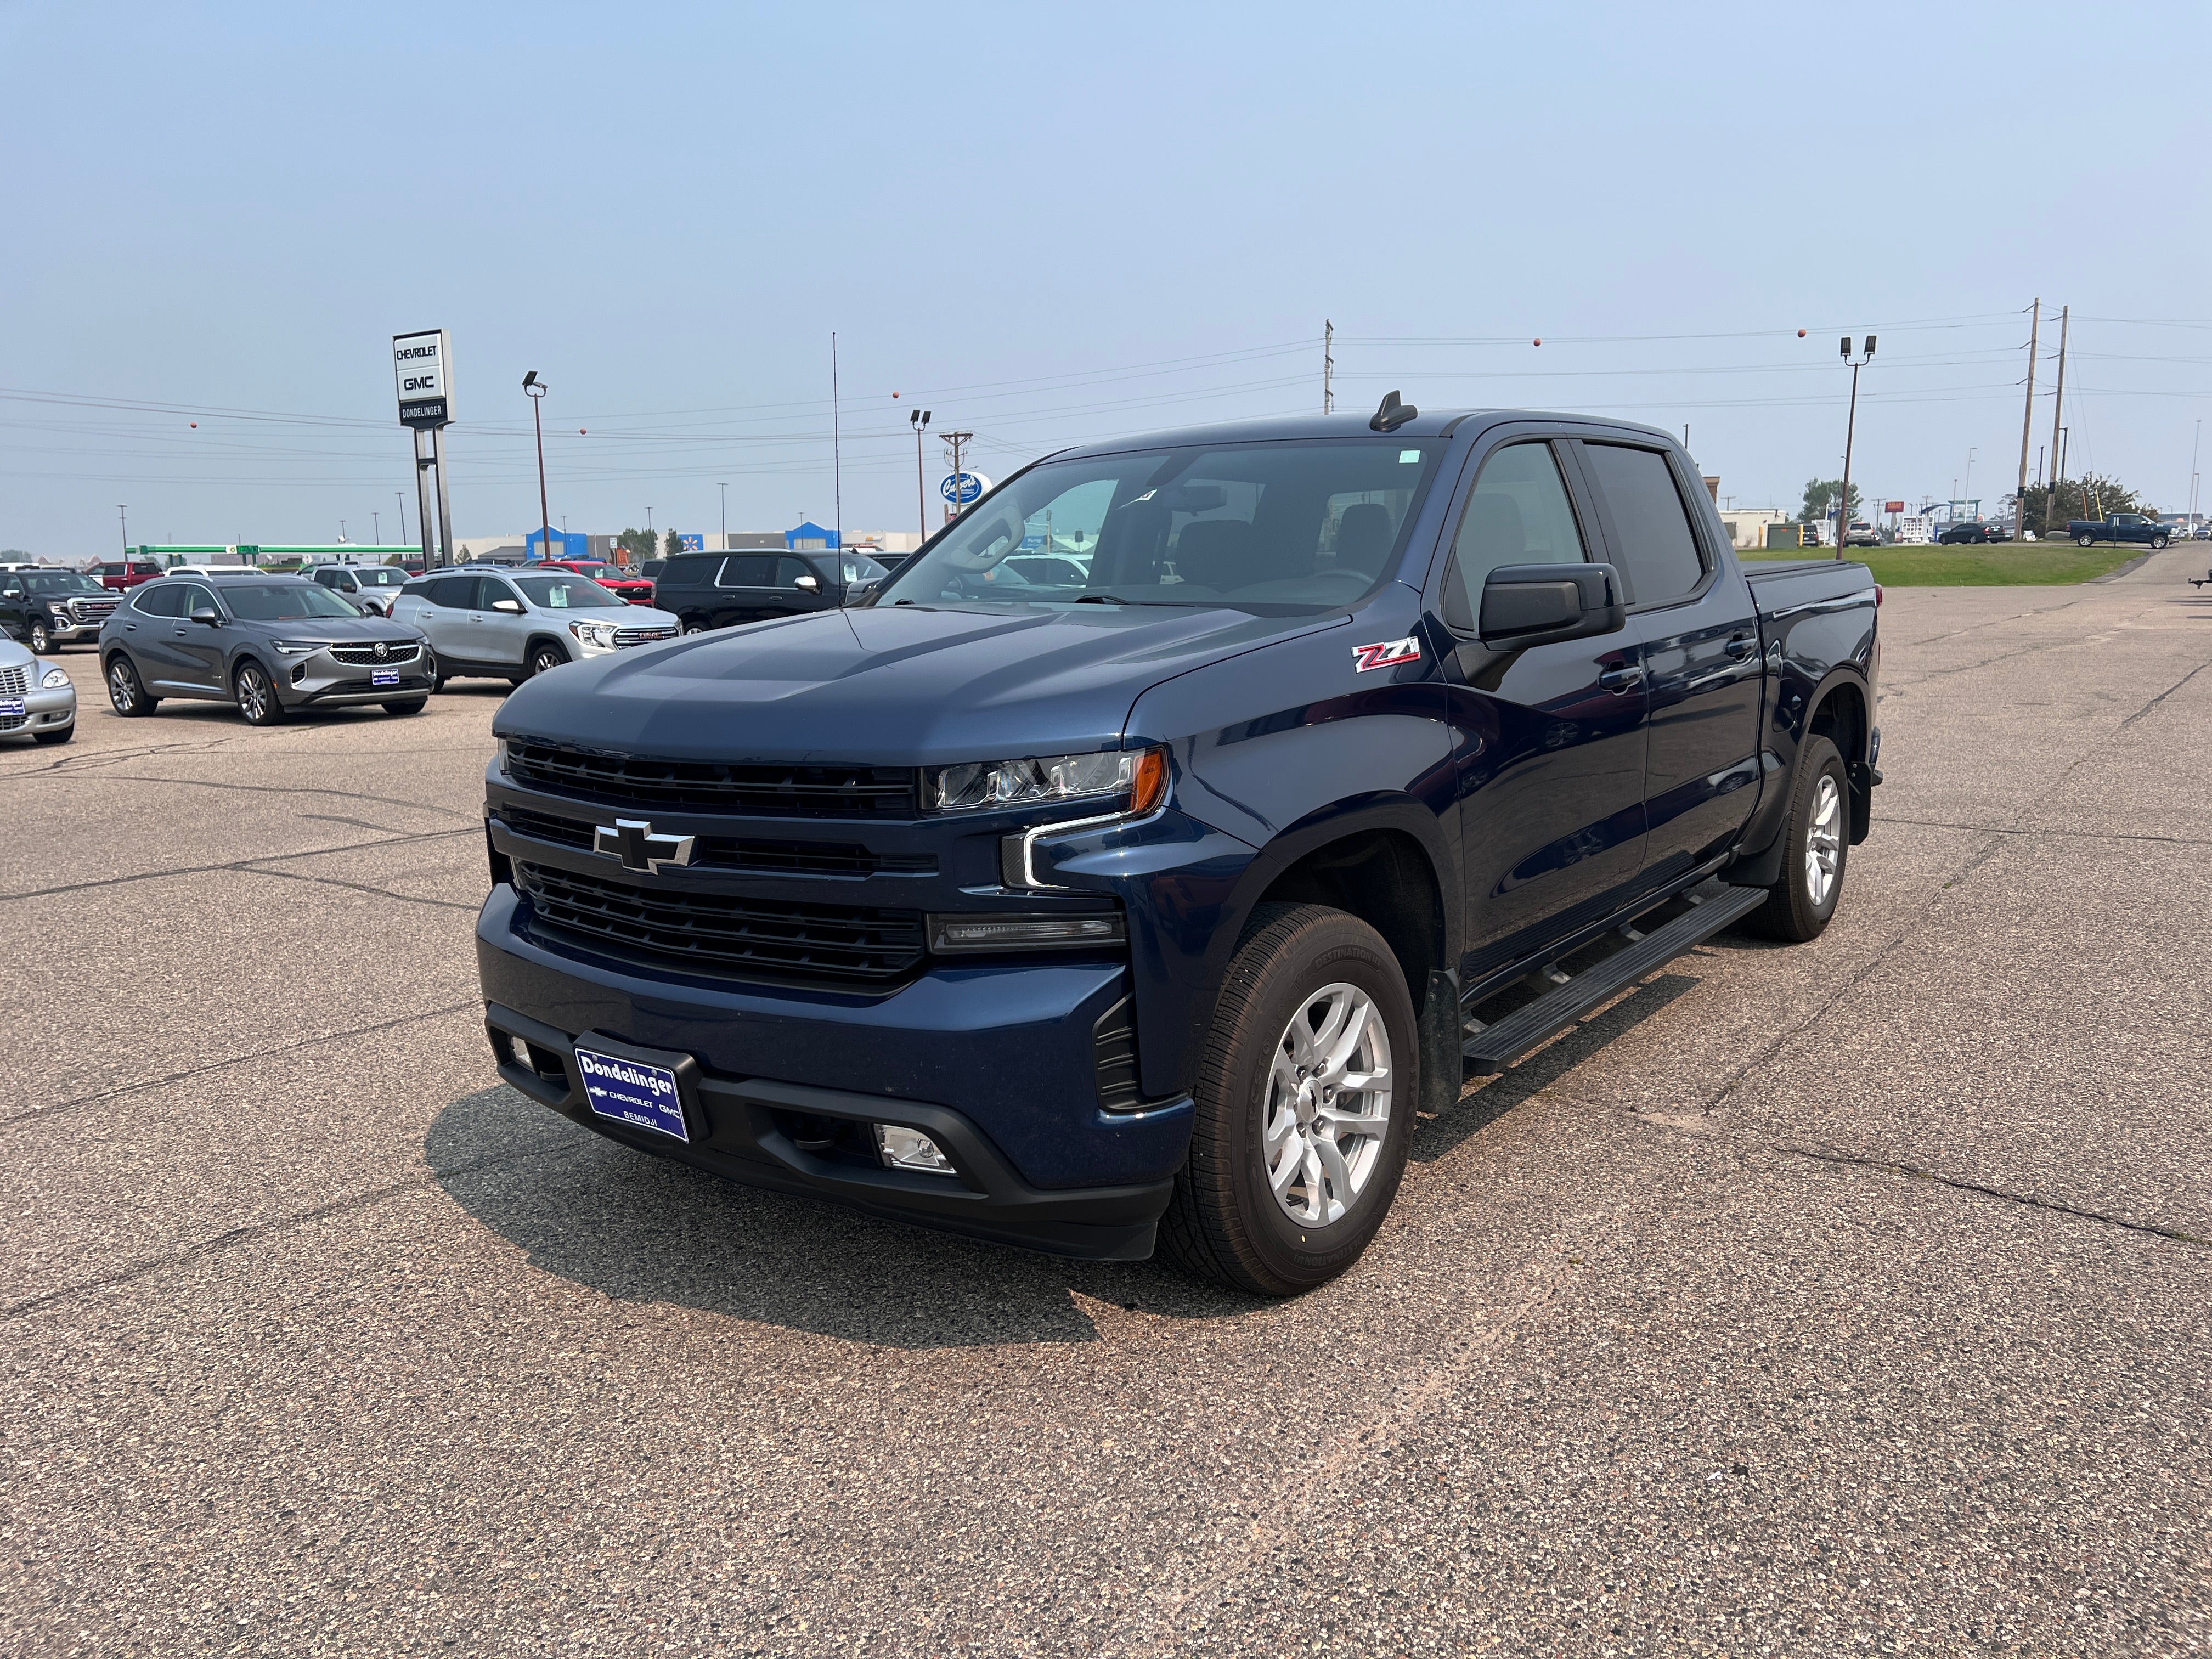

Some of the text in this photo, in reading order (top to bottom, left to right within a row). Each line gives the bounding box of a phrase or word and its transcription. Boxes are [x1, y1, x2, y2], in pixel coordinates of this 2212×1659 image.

[397, 346, 437, 360] CHEVROLET
[404, 376, 434, 391] GMC
[402, 405, 442, 419] DONDELINGER
[943, 474, 976, 496] Cuver's
[1350, 636, 1421, 674] Z71
[1315, 947, 1372, 969] DESTINATION
[580, 1056, 673, 1097] Dondelinger
[609, 1091, 680, 1119] CHEVROLET GMC
[623, 1111, 657, 1126] BEMIDJI
